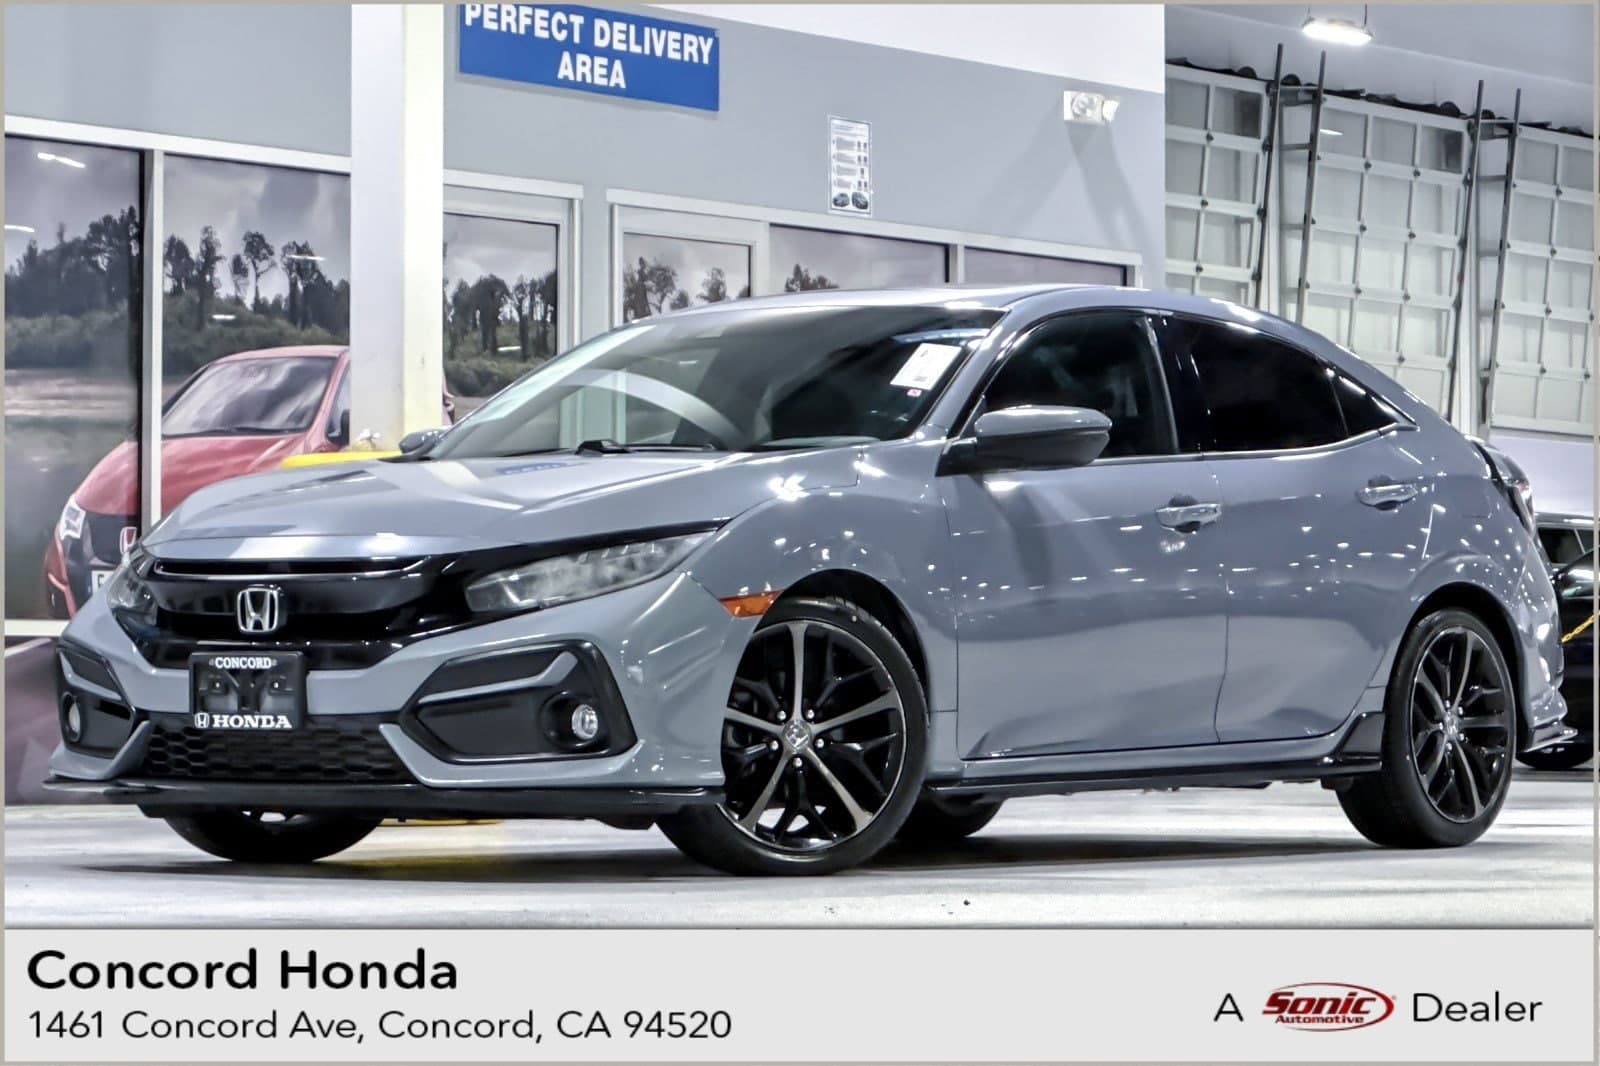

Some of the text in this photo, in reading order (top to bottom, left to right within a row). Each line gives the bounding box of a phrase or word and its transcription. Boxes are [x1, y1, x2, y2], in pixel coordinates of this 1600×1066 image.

[464, 4, 714, 64] PERFECT DELIVERY
[557, 51, 627, 89] AREA
[214, 656, 272, 669] CONCORD
[212, 714, 293, 729] HONDA
